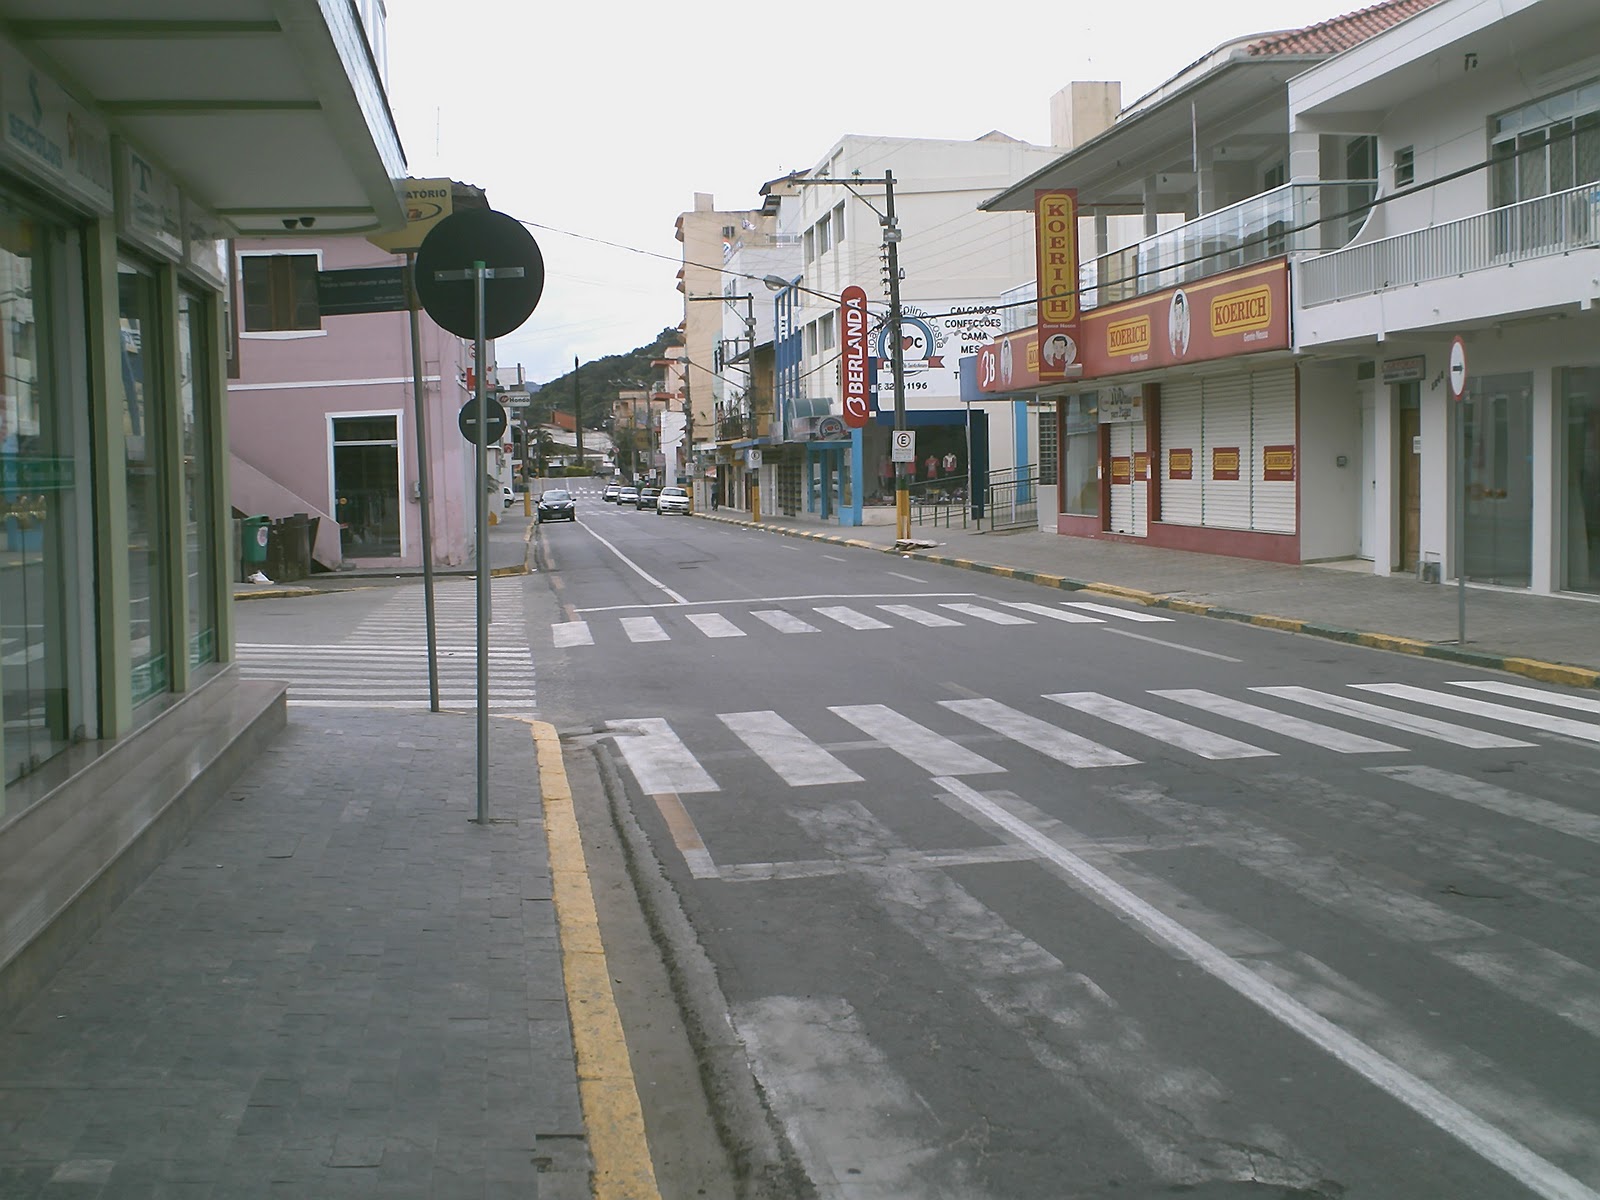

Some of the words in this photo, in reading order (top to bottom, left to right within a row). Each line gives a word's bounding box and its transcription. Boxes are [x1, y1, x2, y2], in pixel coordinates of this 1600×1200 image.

[406, 188, 448, 199] ATÓRIO
[1047, 203, 1069, 314] KOERICH
[1214, 295, 1267, 327] KOERICH
[847, 297, 864, 394] BERLANDA
[961, 332, 988, 341] CAMA
[1109, 324, 1148, 348] KOERICH
[960, 345, 980, 354] MES
